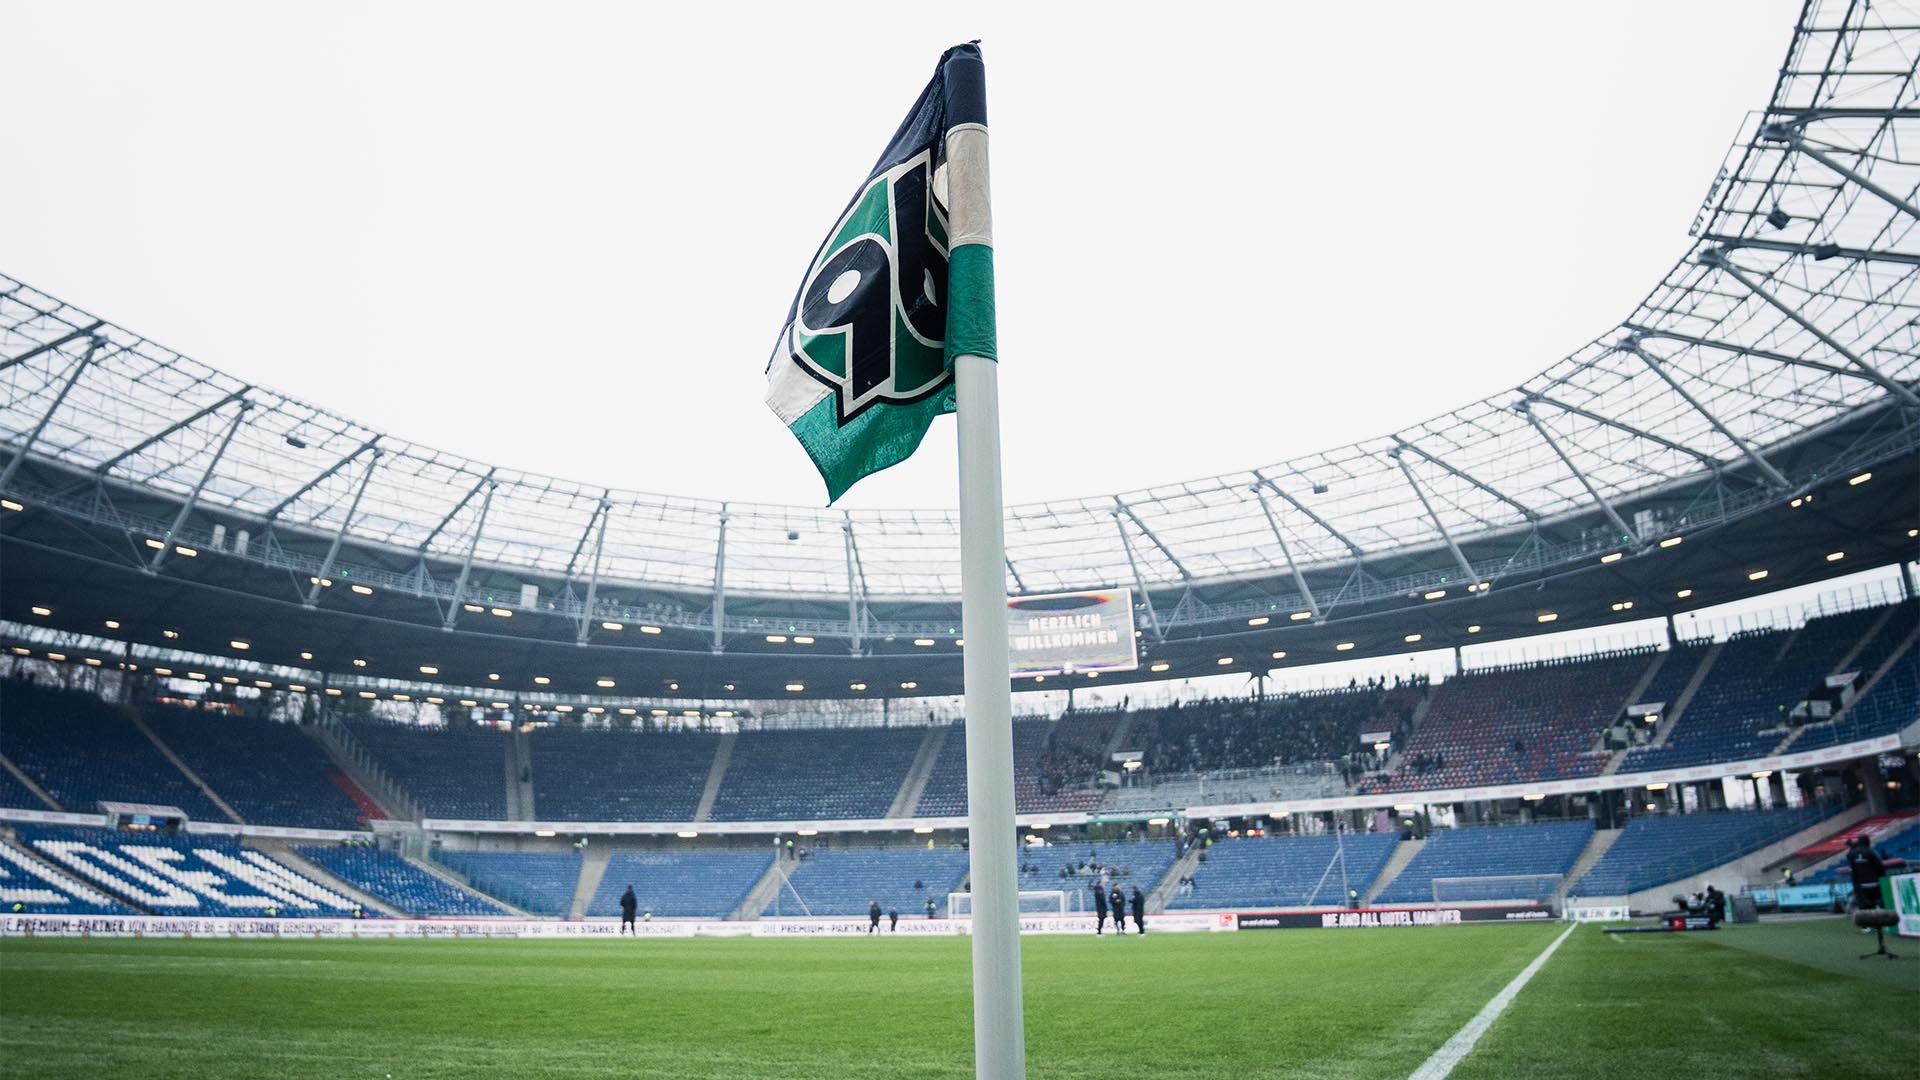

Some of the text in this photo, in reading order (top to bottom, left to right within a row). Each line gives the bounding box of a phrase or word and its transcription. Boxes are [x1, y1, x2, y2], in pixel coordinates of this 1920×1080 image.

[1028, 613, 1101, 631] HERZLICH
[1015, 629, 1118, 650] WILLKOMMEN
[17, 918, 125, 932] PREMIUM-PARTNER
